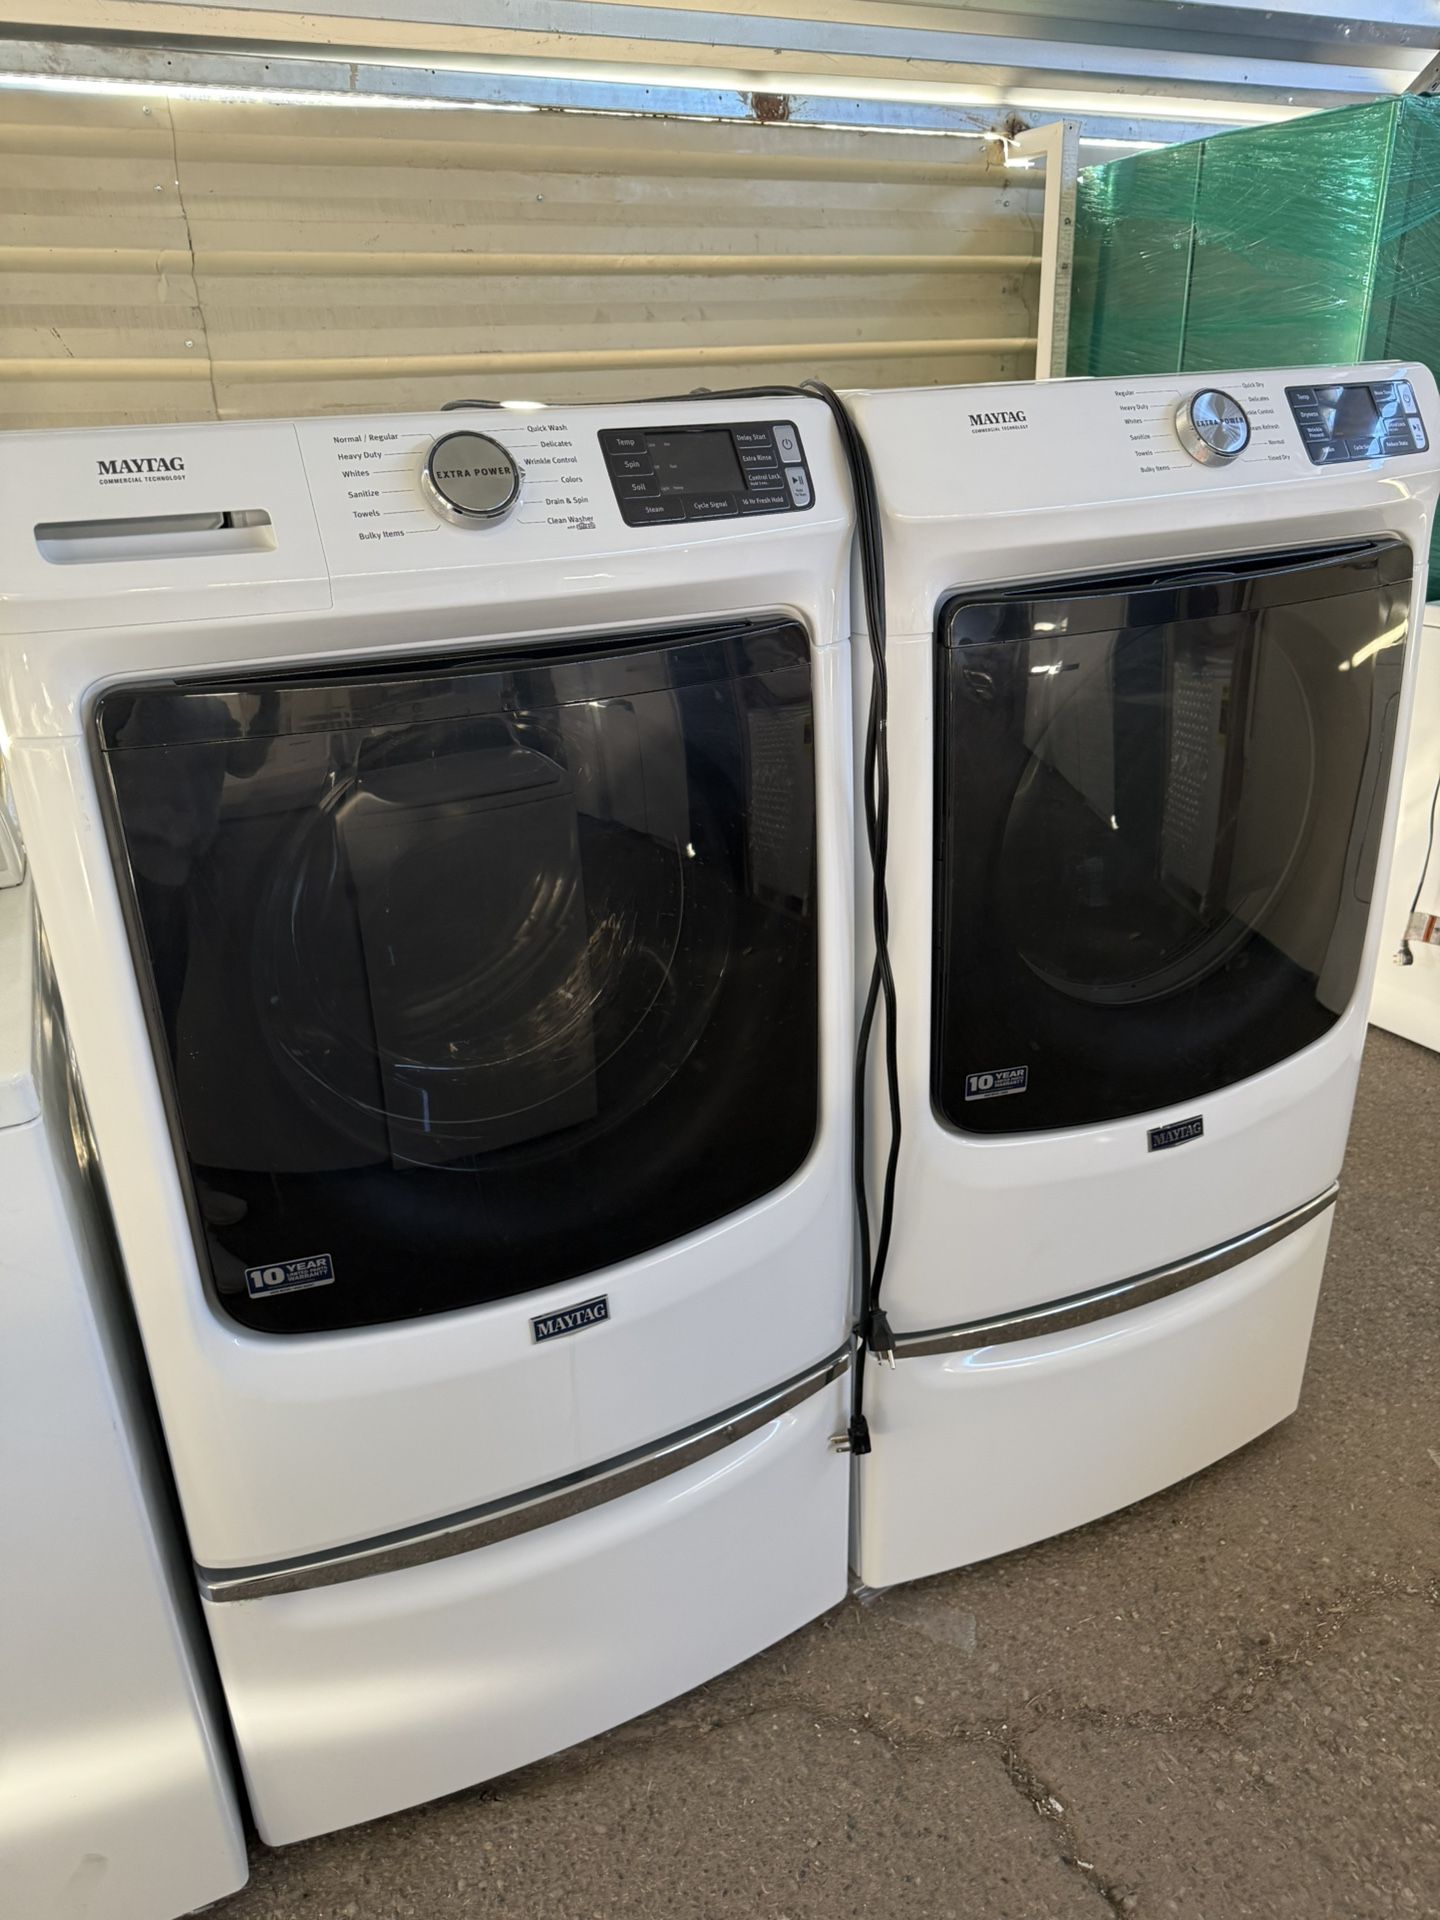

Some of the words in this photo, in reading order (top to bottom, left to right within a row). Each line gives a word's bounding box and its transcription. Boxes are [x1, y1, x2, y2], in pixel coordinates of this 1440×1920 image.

[968, 410, 1026, 426] MAYTAG
[333, 435, 362, 443] Normal
[369, 433, 398, 442] Regular
[96, 456, 185, 475] MAYTAG
[524, 457, 551, 465] Wrinkle
[552, 456, 577, 464] Control
[624, 461, 640, 469] Spin
[342, 470, 370, 478] Whites
[436, 469, 471, 479] EXTRA
[474, 466, 511, 476] POWER
[99, 477, 142, 485] COMMERCIAL
[348, 490, 380, 498] Sanitize
[573, 496, 588, 504] Spin
[694, 502, 709, 510] Cycle
[709, 501, 728, 509] Signal
[353, 509, 380, 518] Towels
[568, 515, 594, 523] Washer
[359, 532, 381, 540] Bulky
[383, 530, 405, 538] Items
[970, 1074, 993, 1092] 10
[995, 1069, 1025, 1079] YEAR
[1153, 1122, 1201, 1146] MAYTAG
[250, 1267, 285, 1288] 10
[286, 1258, 327, 1272] YEAR
[287, 1271, 328, 1282] WARRANTY
[537, 1304, 605, 1337] MAYTAG
